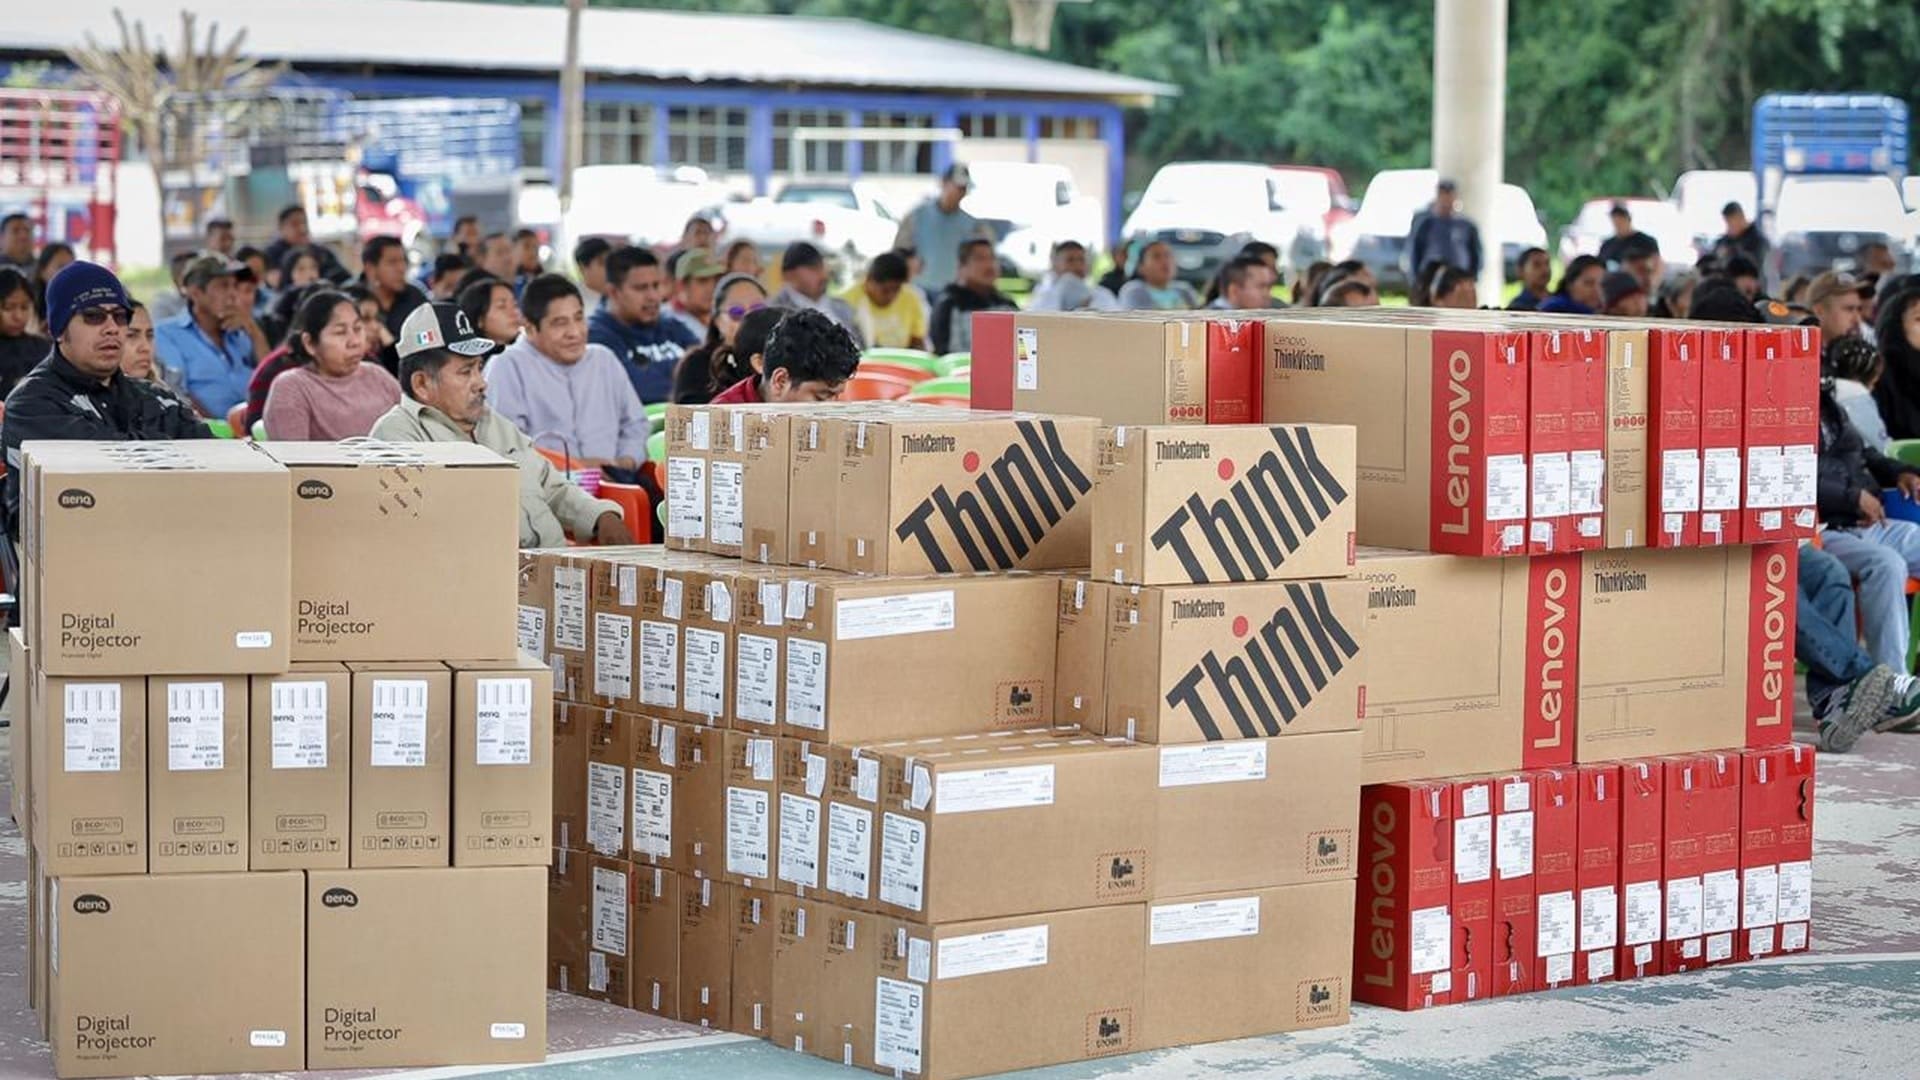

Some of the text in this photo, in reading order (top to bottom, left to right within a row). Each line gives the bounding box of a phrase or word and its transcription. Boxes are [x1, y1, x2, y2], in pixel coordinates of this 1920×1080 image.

[1273, 333, 1307, 346] Lenovo
[1274, 348, 1326, 371] ThinkVision
[901, 433, 956, 454] ThinkCentre
[1156, 439, 1210, 460] ThinkCentre
[1441, 350, 1471, 535] Lenovo
[895, 420, 1092, 573] Think
[1150, 426, 1348, 584] Think
[1594, 558, 1629, 570] Lenovo
[1594, 570, 1647, 593] ThinkVision
[1367, 584, 1416, 609] inkVision
[298, 600, 350, 620] Digital
[1172, 598, 1225, 620] ThinkCentre
[61, 613, 115, 633] Digital
[298, 618, 375, 638] Projector
[61, 632, 142, 652] Projector
[1756, 553, 1786, 726] Lenovo
[1165, 581, 1360, 742] Think
[1534, 568, 1567, 748] Lenovo
[1364, 801, 1397, 988] Lenovo
[77, 1014, 130, 1035] Digital
[324, 1007, 377, 1028] Digital
[77, 1034, 156, 1053] Projector
[324, 1026, 402, 1045] Projector
